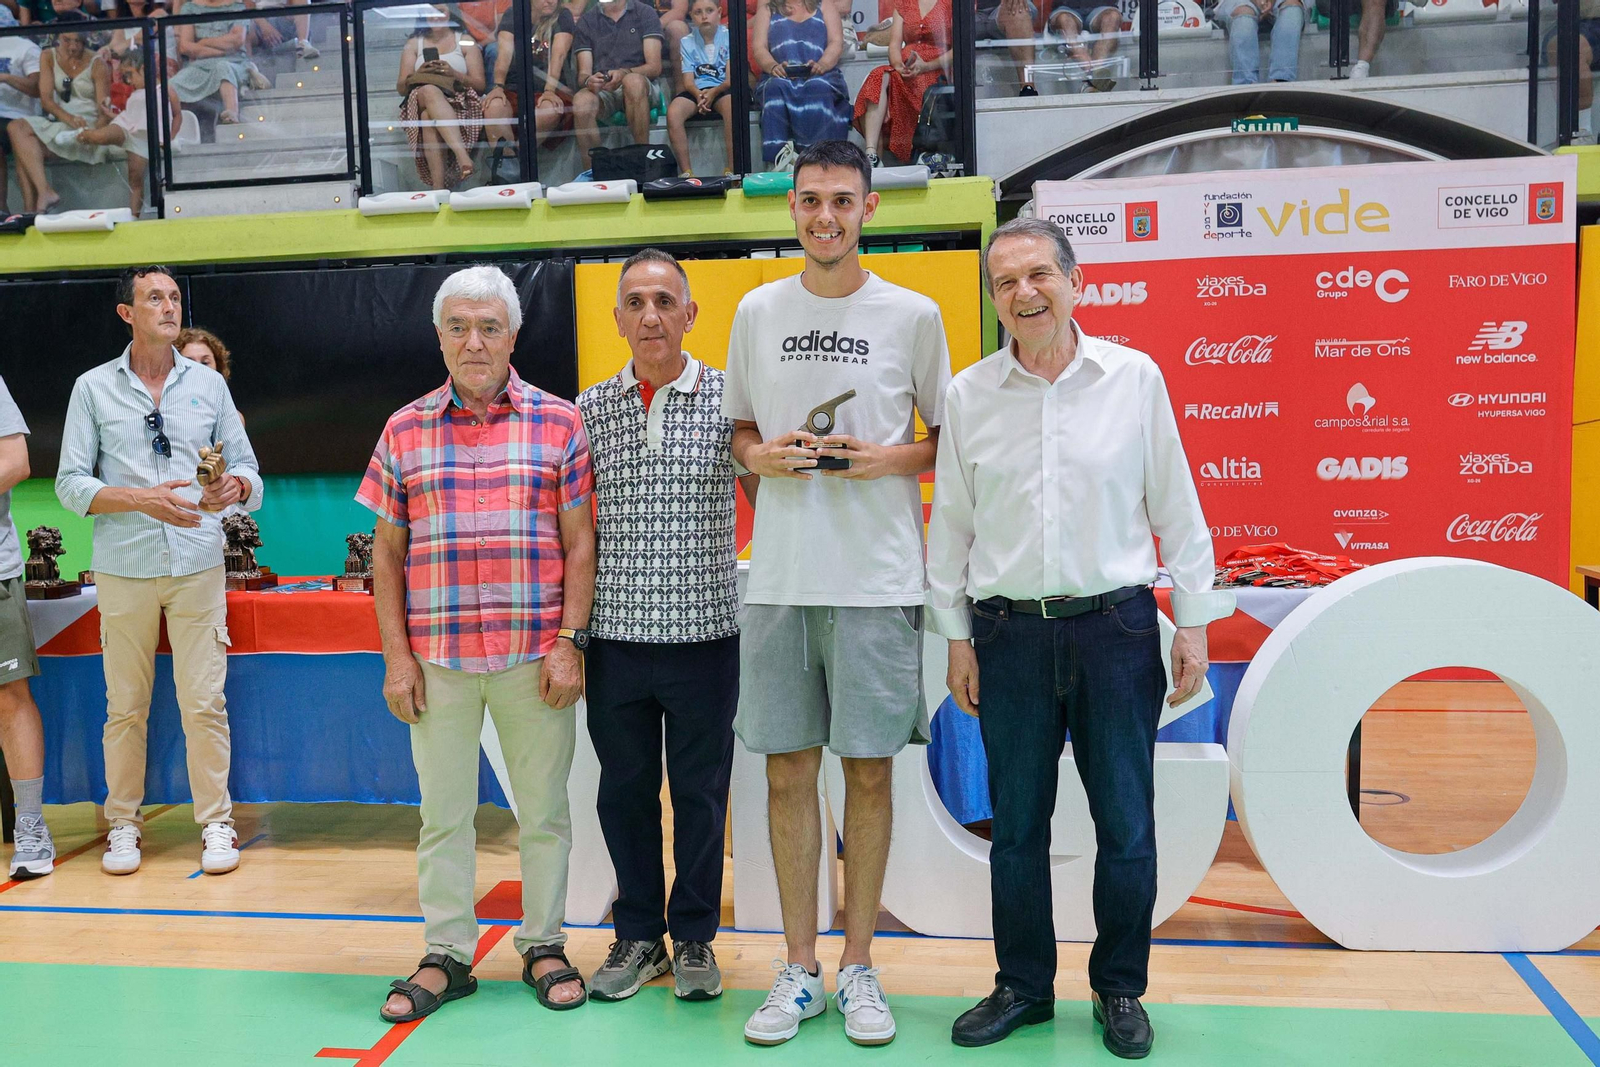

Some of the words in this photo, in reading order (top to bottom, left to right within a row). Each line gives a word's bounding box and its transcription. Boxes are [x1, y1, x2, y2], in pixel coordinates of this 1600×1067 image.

[1445, 193, 1518, 207] CONCELLO
[1048, 212, 1116, 225] CONCELLO
[1257, 188, 1390, 237] vide
[1453, 209, 1471, 219] DE
[1476, 207, 1509, 218] VIGO
[1077, 225, 1108, 236] VIGO
[1204, 229, 1252, 241] deporte
[1196, 275, 1245, 286] viaxes
[1449, 275, 1486, 288] FARO
[1490, 275, 1509, 287] DE
[1511, 272, 1548, 286] VIGO
[1316, 289, 1348, 299] Grupo
[781, 330, 870, 356] adidas
[1184, 334, 1278, 366] Coca-Cola
[1315, 345, 1346, 358] Mar
[1351, 345, 1371, 357] de
[1377, 344, 1411, 356] Ons
[780, 354, 869, 365] SPORTSWEAR
[1456, 355, 1481, 365] new
[1484, 352, 1537, 364] balance
[1478, 392, 1547, 404] HYUNDAI
[1200, 402, 1263, 420] Recalvi
[1478, 409, 1523, 418] HYUPERSA
[1314, 414, 1388, 430] campos&rial
[1459, 451, 1510, 463] viaxes
[1316, 456, 1410, 481] GADIS
[1333, 509, 1378, 518] avanza
[1224, 526, 1242, 537] DE
[1243, 525, 1278, 537] VIGO
[1446, 512, 1544, 543] Coca-Cola
[1350, 542, 1389, 550] VITRASA
